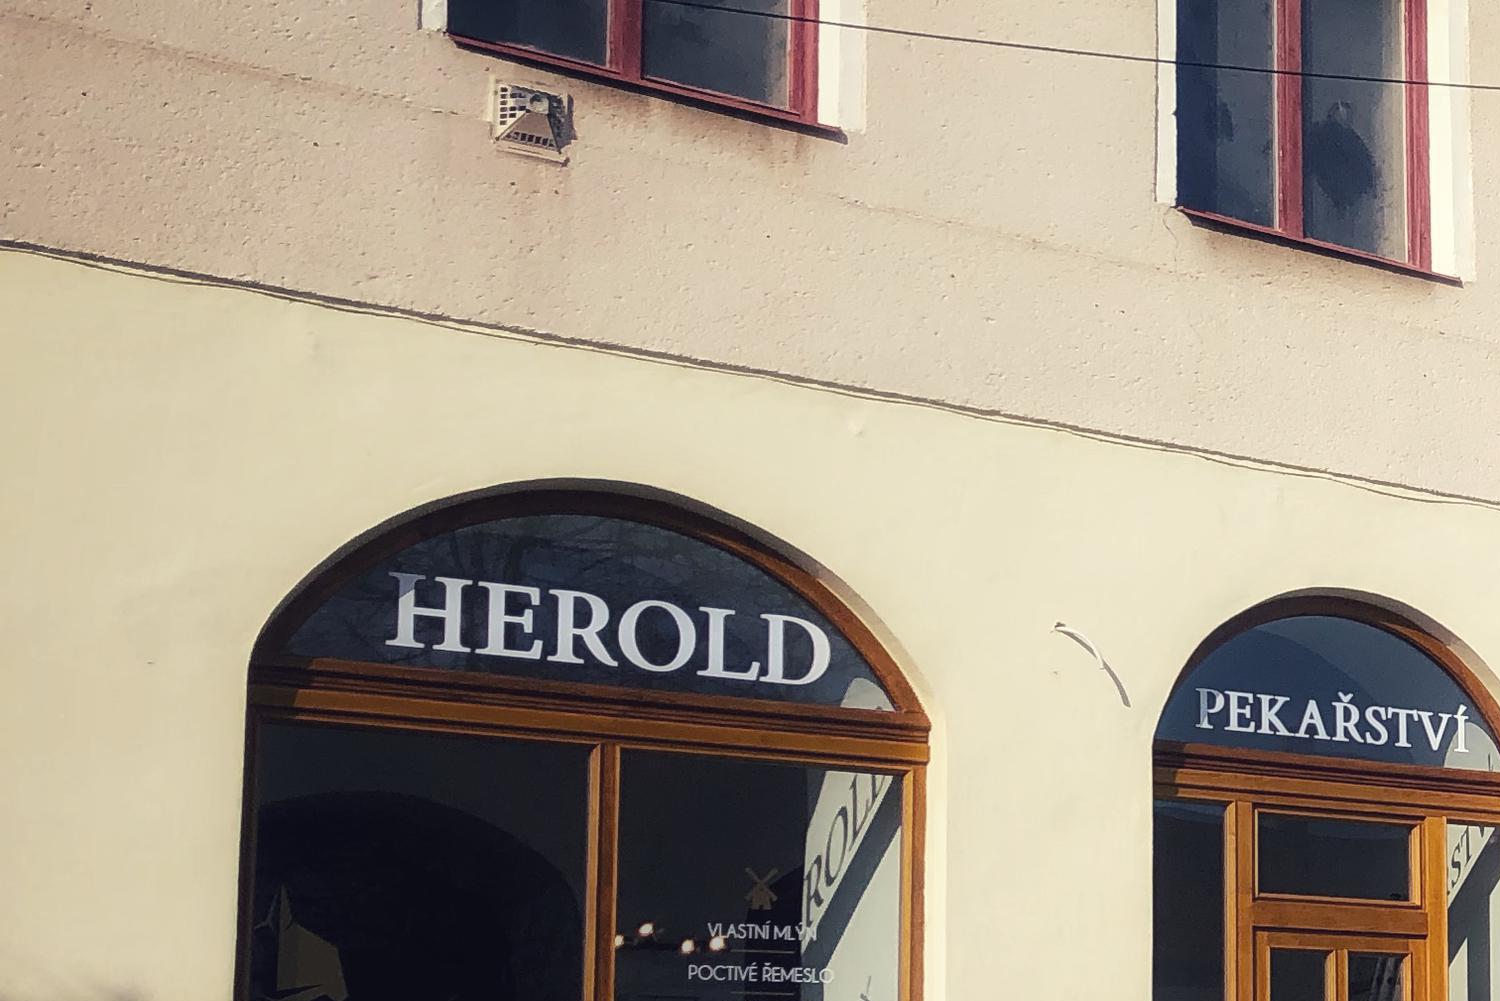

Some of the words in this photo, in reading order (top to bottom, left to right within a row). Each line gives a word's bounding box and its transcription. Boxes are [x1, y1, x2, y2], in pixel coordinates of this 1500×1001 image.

[385, 571, 832, 686] HEROLD
[1195, 687, 1470, 753] PEKAŘSTVÍ
[707, 920, 771, 940] VLASTNÍ
[688, 962, 758, 982] POCTIVÉ
[762, 962, 835, 984] ŘEMESLO
